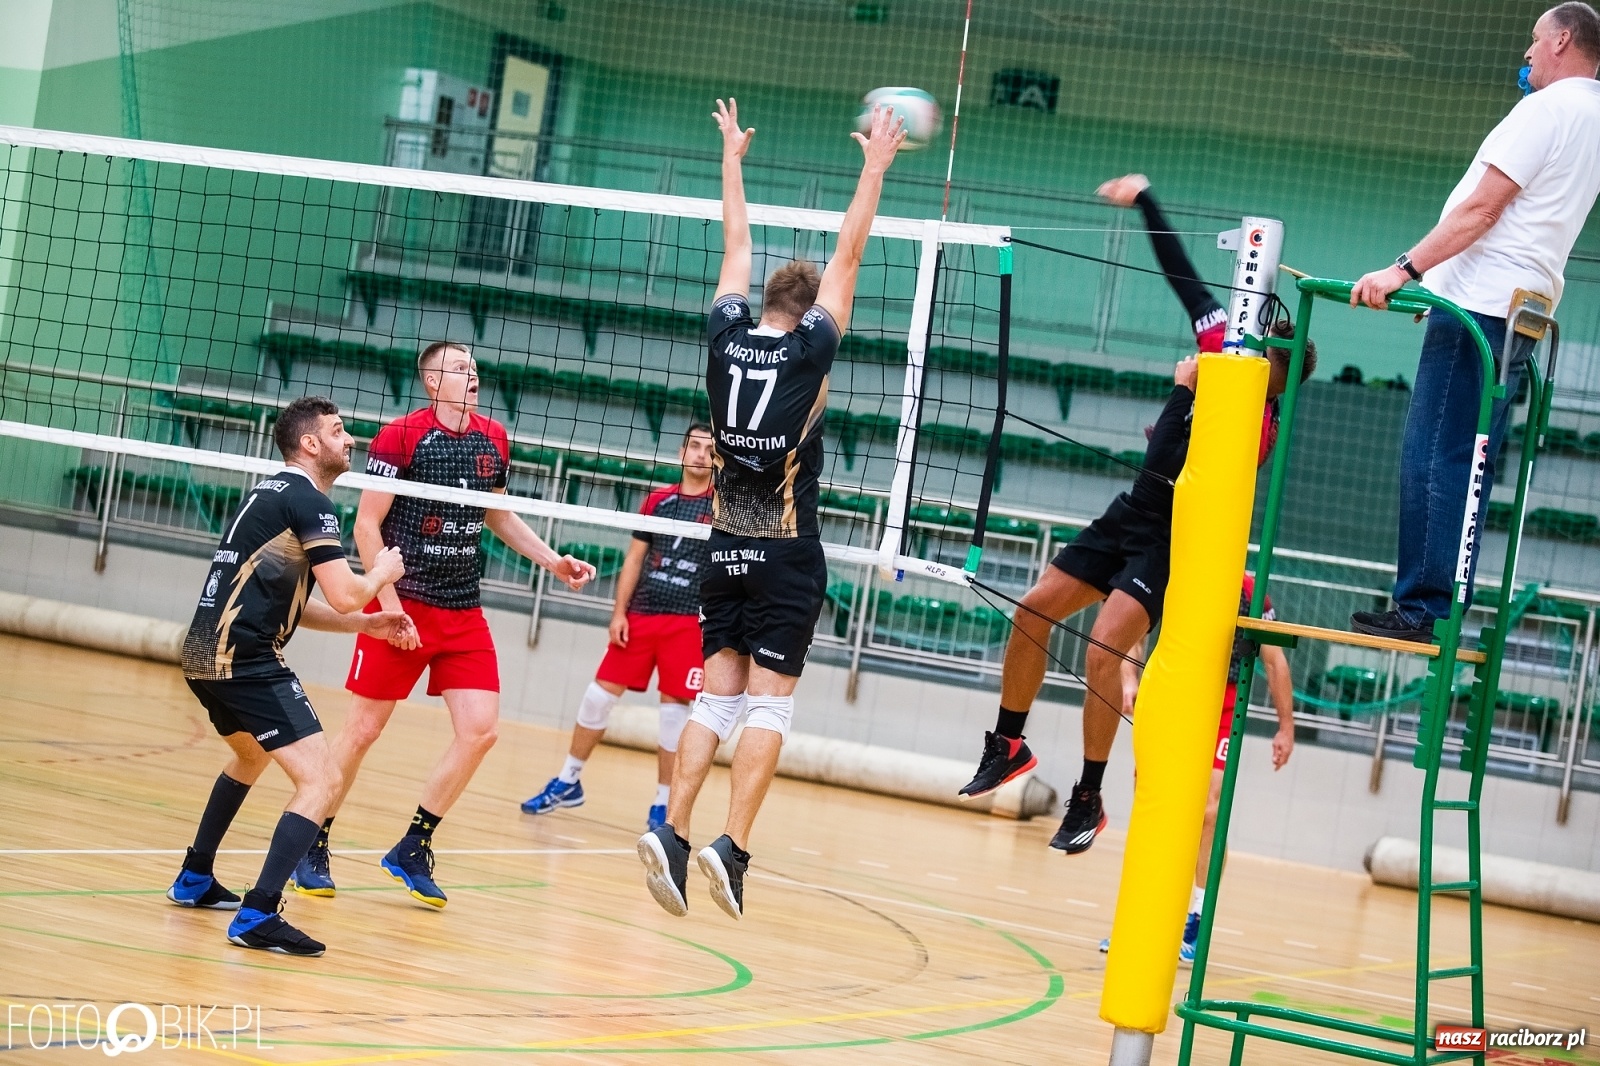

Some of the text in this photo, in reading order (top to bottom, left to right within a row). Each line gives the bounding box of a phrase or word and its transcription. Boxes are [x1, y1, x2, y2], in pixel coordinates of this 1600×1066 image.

[727, 363, 778, 431] 17
[720, 429, 787, 451] AGROTIM
[226, 493, 258, 544] 1
[354, 648, 364, 681] 1
[758, 647, 785, 661] AGROTIM
[304, 701, 317, 721] 1
